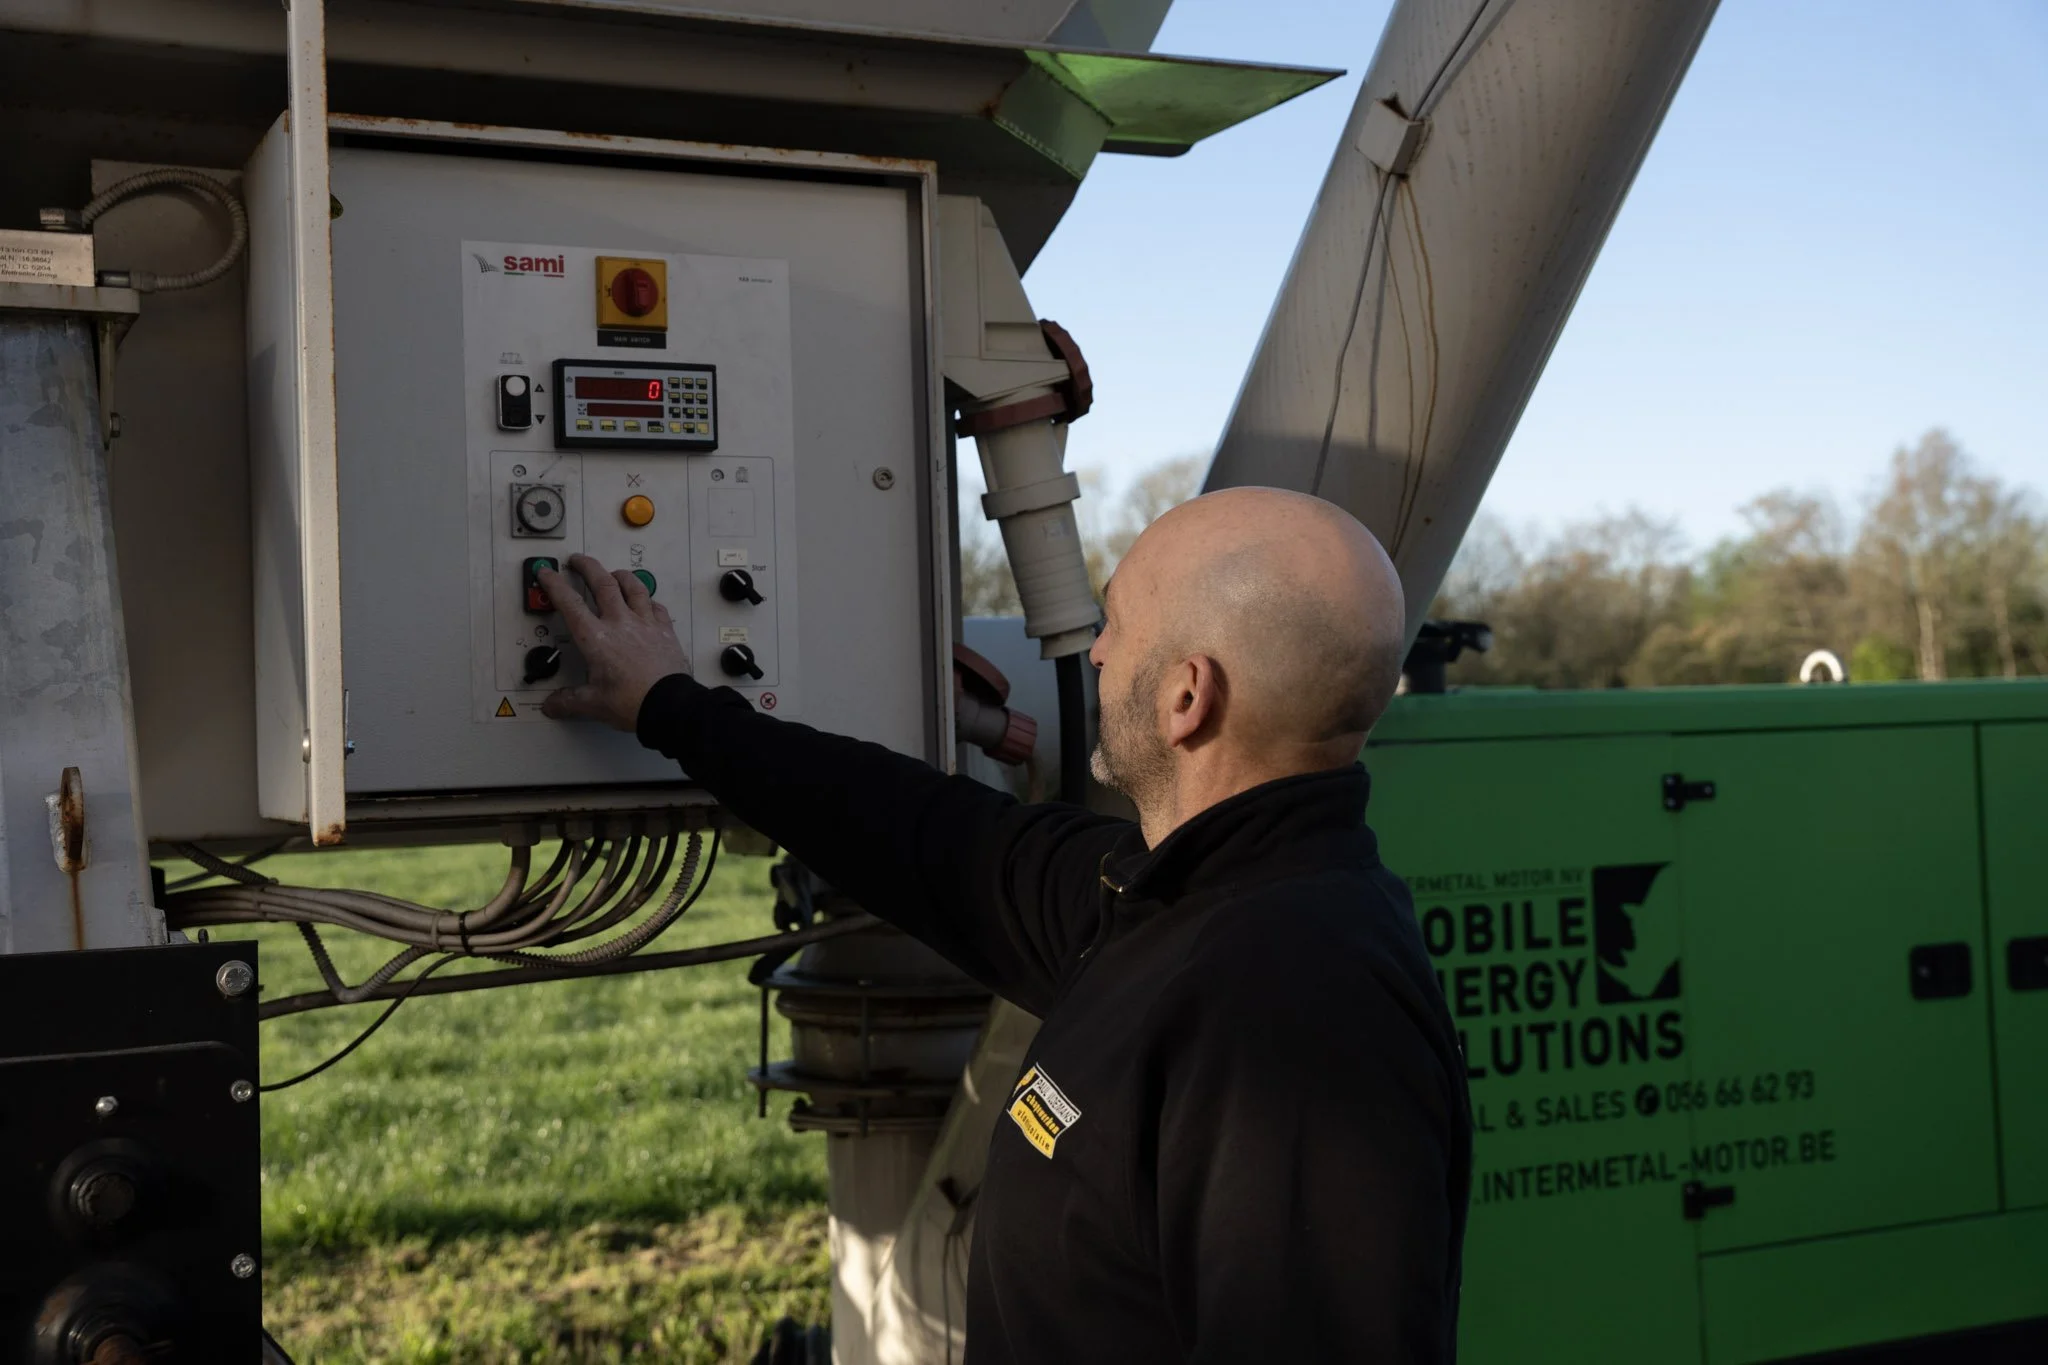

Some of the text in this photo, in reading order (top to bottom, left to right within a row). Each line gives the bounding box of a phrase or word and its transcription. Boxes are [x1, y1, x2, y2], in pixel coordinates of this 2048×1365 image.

[503, 254, 565, 274] sami
[648, 381, 660, 399] 0
[1493, 868, 1554, 888] MOTOR
[1560, 867, 1584, 883] NV
[1422, 896, 1588, 958] OBILE
[1434, 957, 1587, 1018] ERGY
[1458, 1010, 1685, 1079] LUTIONS
[1034, 1078, 1050, 1097] PAUL
[1505, 1099, 1526, 1130] &
[1535, 1089, 1628, 1128] SALES
[1664, 1079, 1708, 1112] 056
[1714, 1075, 1745, 1108] 66
[1750, 1072, 1780, 1105] 62
[1784, 1069, 1816, 1100] 93
[1474, 1129, 1837, 1205] .INTERMETAL-MOTOR.BE
